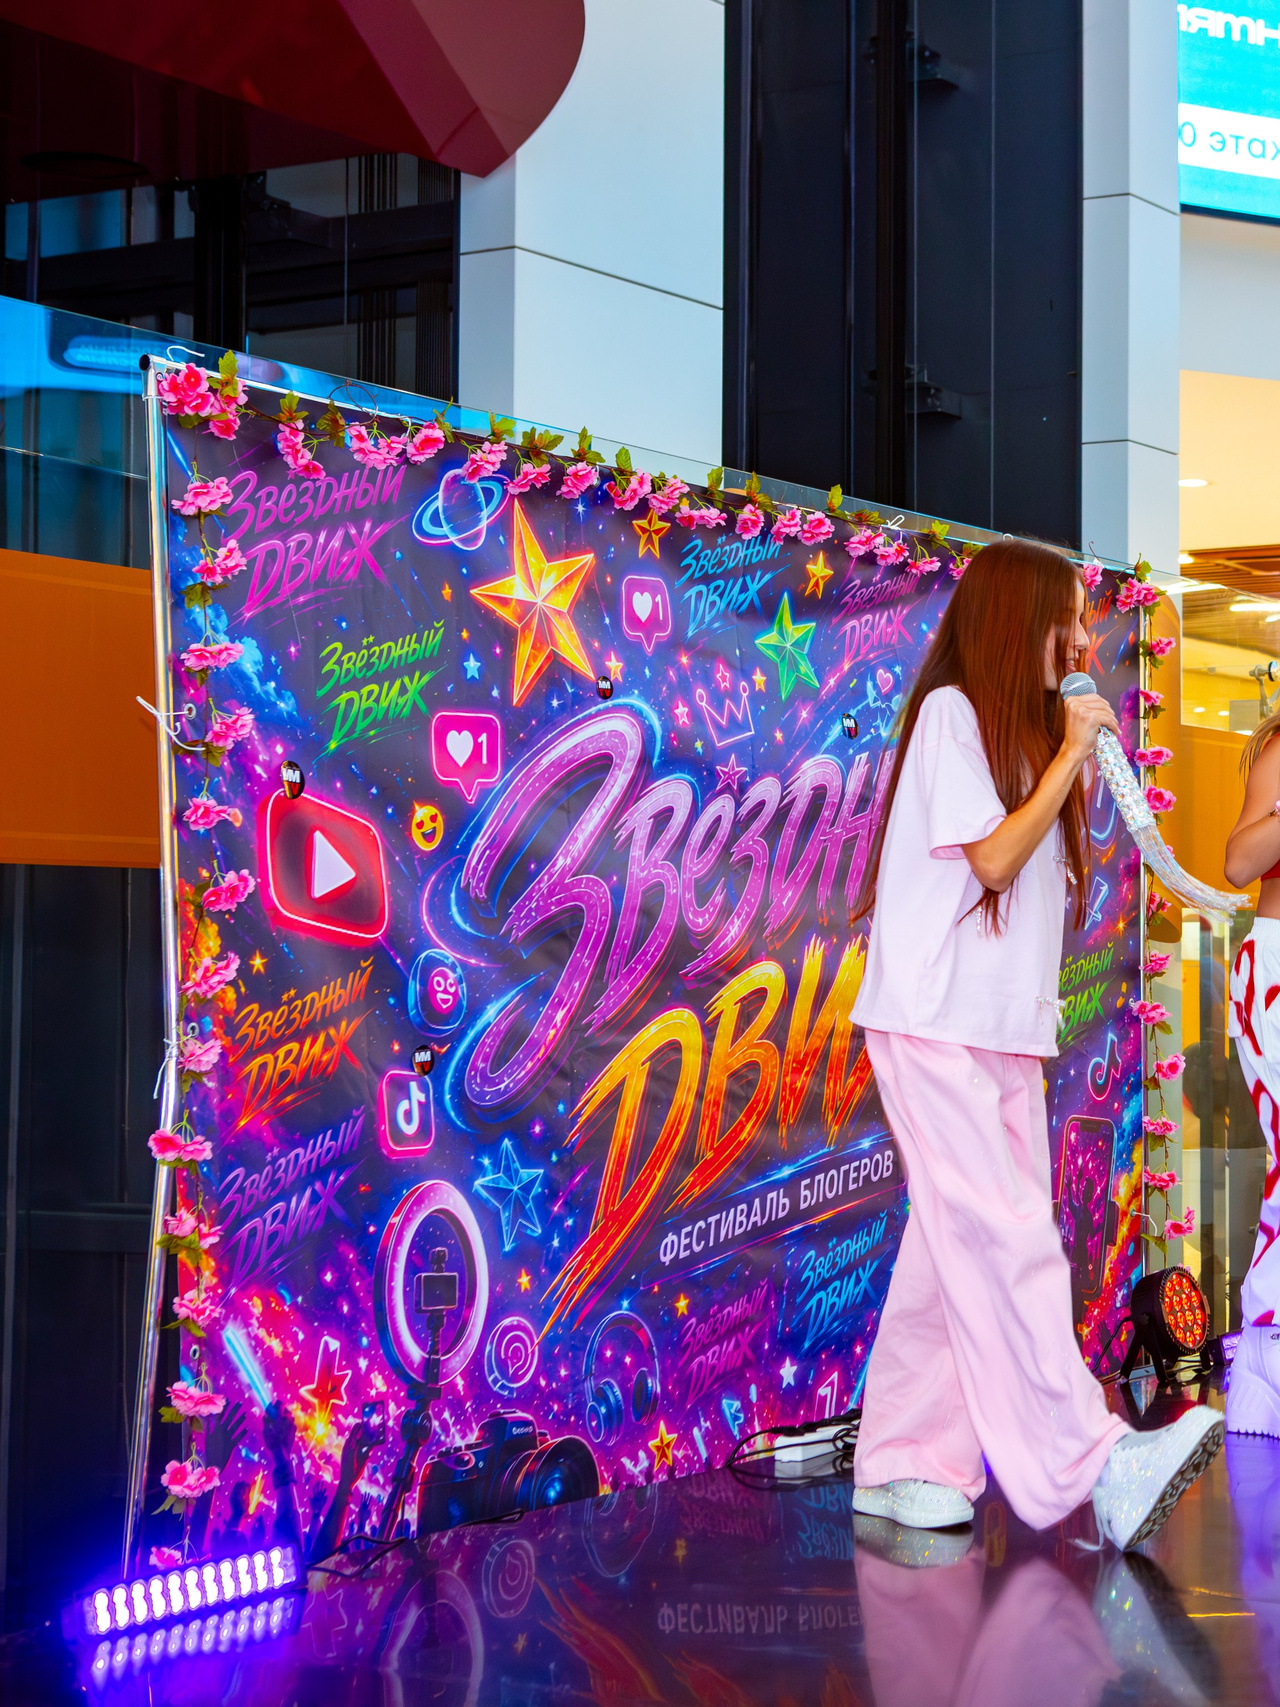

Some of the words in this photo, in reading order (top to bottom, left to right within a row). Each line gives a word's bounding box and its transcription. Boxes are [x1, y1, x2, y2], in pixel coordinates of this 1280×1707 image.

[654, 595, 663, 621] 1
[477, 732, 488, 766] 1
[1058, 980, 1112, 1045] ВИЖ
[530, 932, 875, 1352] ДВИ
[659, 1188, 790, 1266] ФЕСТИВАЛЬ
[800, 1150, 894, 1211] БЛОГЕРОВ
